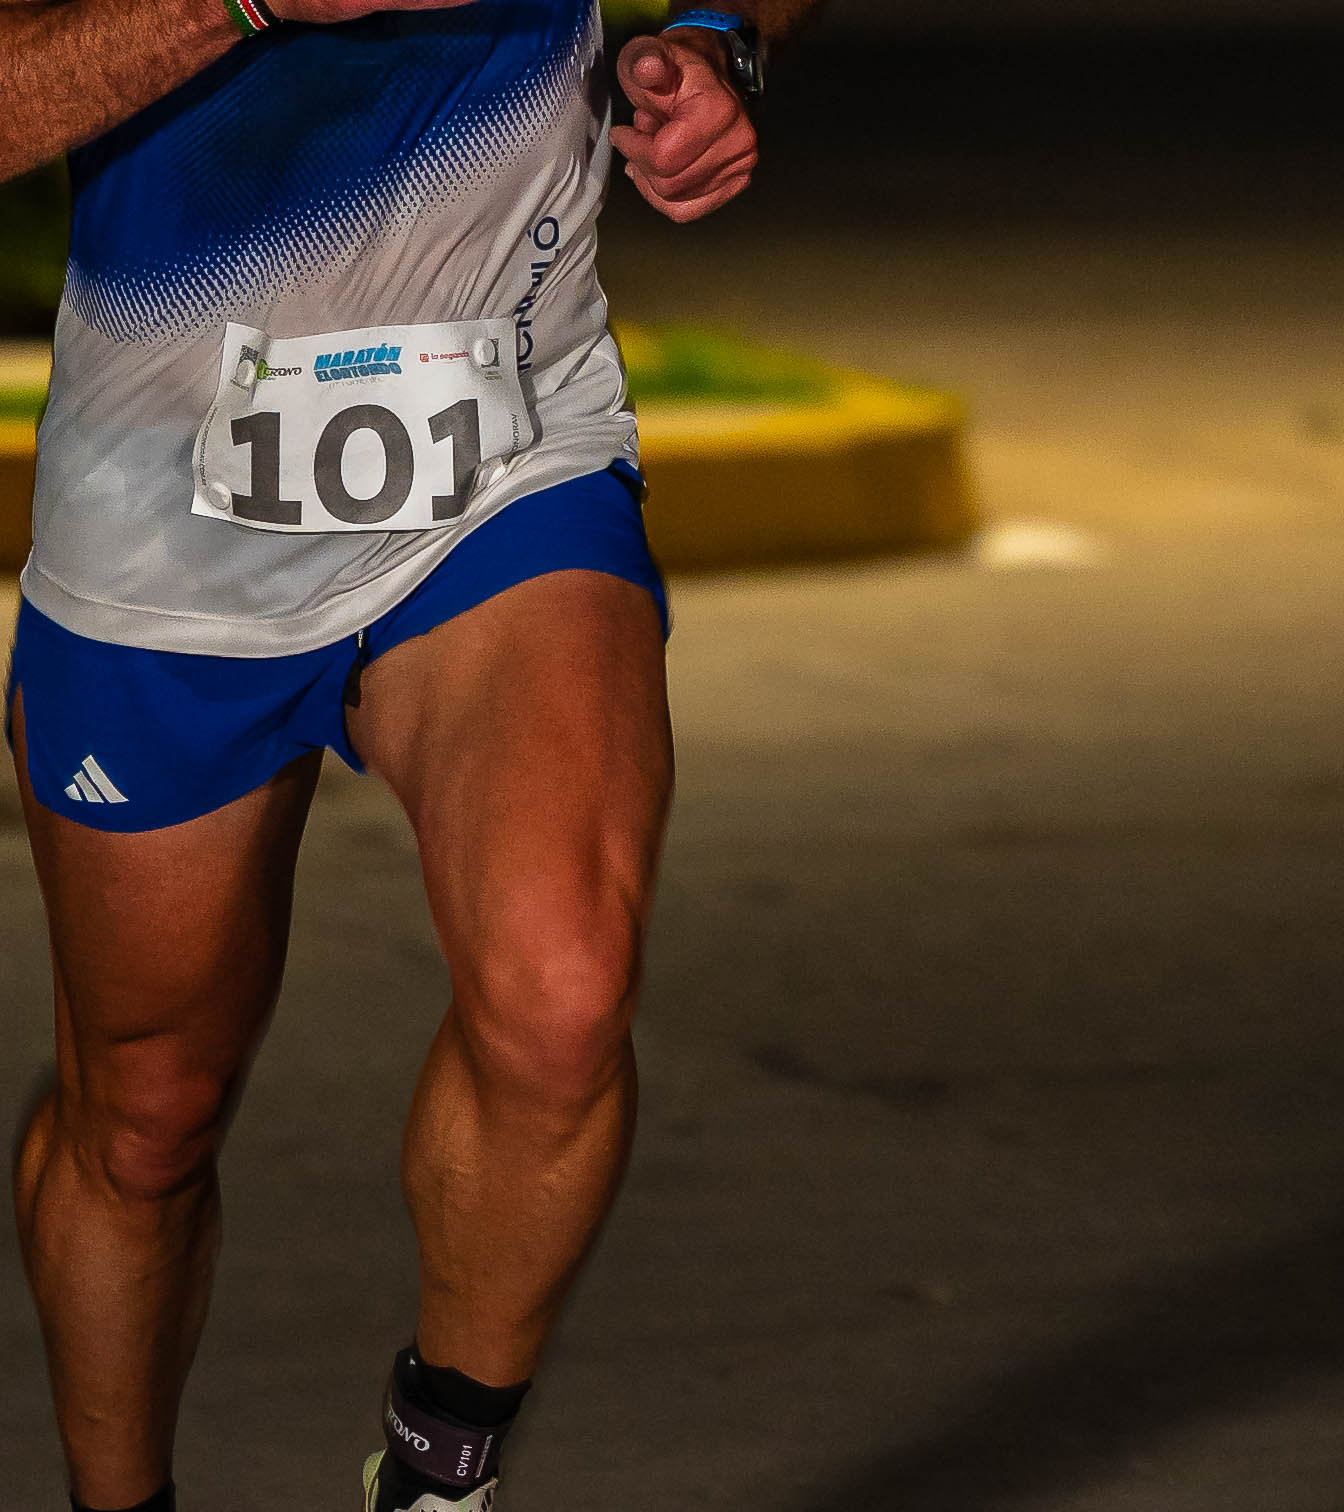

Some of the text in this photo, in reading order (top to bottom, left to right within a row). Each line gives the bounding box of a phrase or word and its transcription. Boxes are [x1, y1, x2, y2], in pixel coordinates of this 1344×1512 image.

[314, 343, 402, 370] MARATÓN
[230, 399, 481, 525] 101
[456, 1444, 473, 1477] CV101
